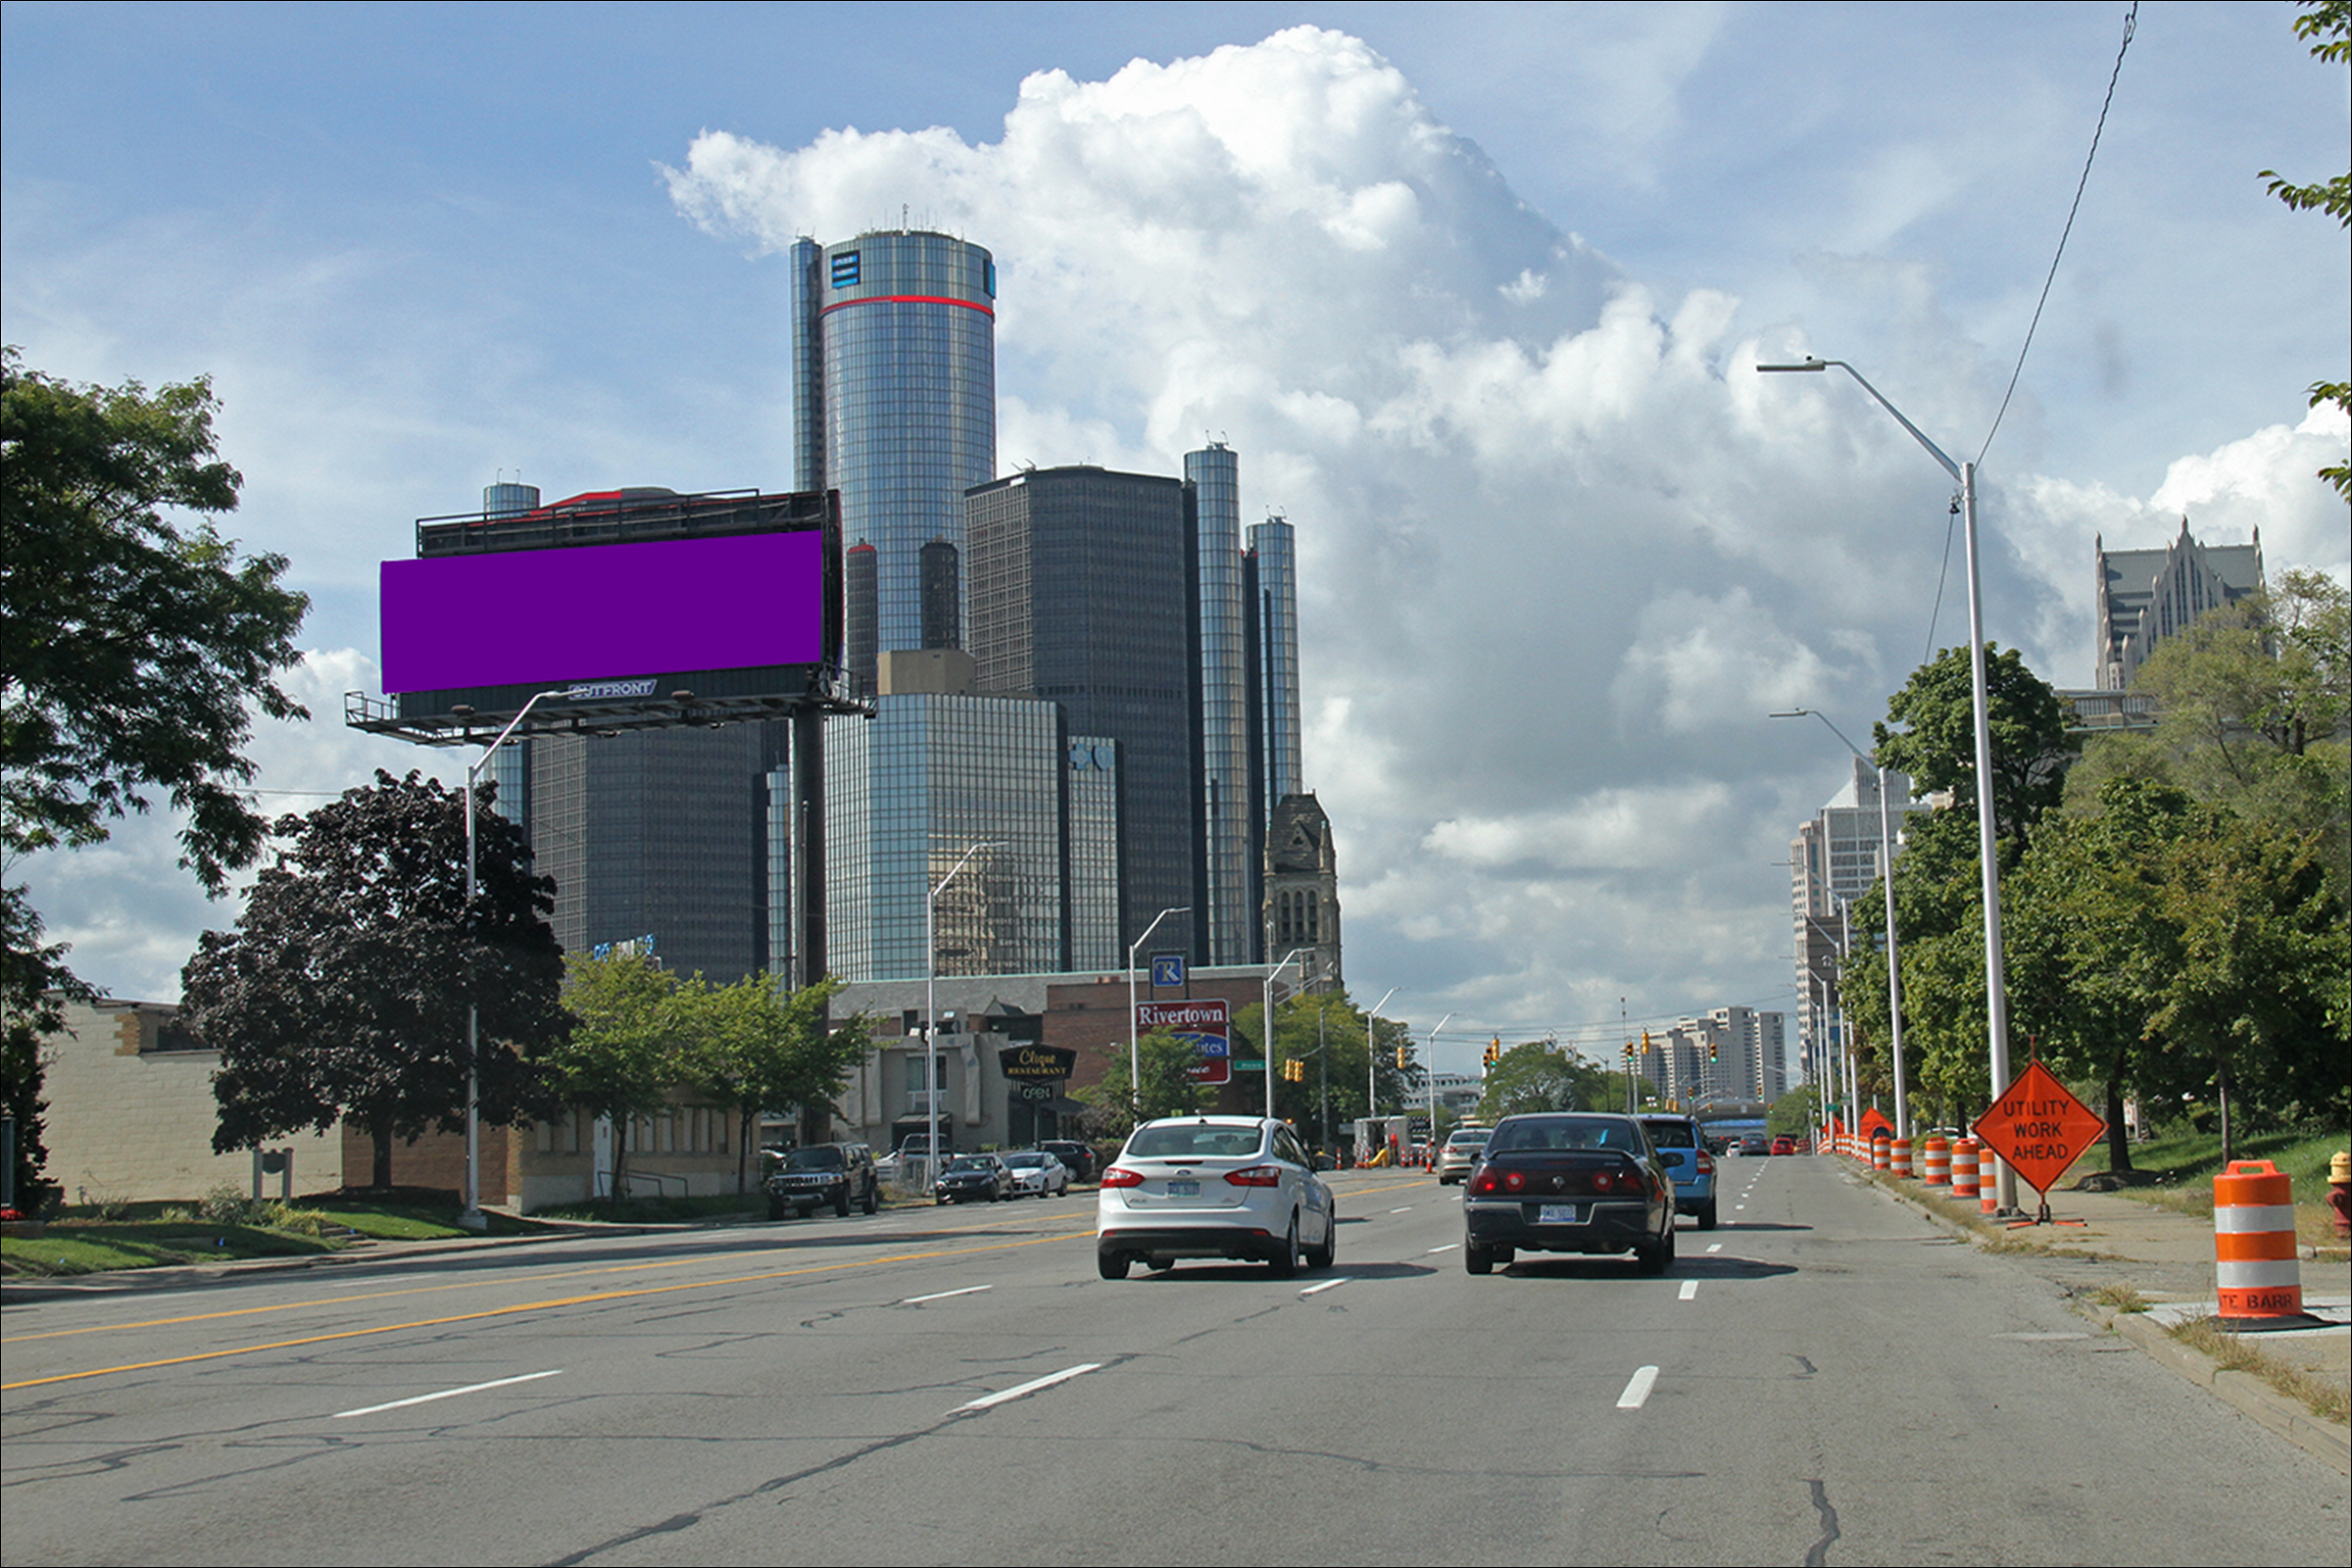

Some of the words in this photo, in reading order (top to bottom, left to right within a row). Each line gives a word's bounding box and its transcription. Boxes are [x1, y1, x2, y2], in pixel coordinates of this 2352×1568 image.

[572, 681, 652, 698] OUTFRONT
[1139, 1005, 1223, 1026] Rivertown
[1019, 1049, 1056, 1067] Clique
[1007, 1066, 1067, 1076] RESTAURANT
[1022, 1087, 1052, 1100] OPEN
[2003, 1100, 2070, 1117] UTILITY
[2013, 1122, 2063, 1139] WORK
[2012, 1144, 2069, 1160] AHEAD
[2247, 1294, 2293, 1308] BARR
